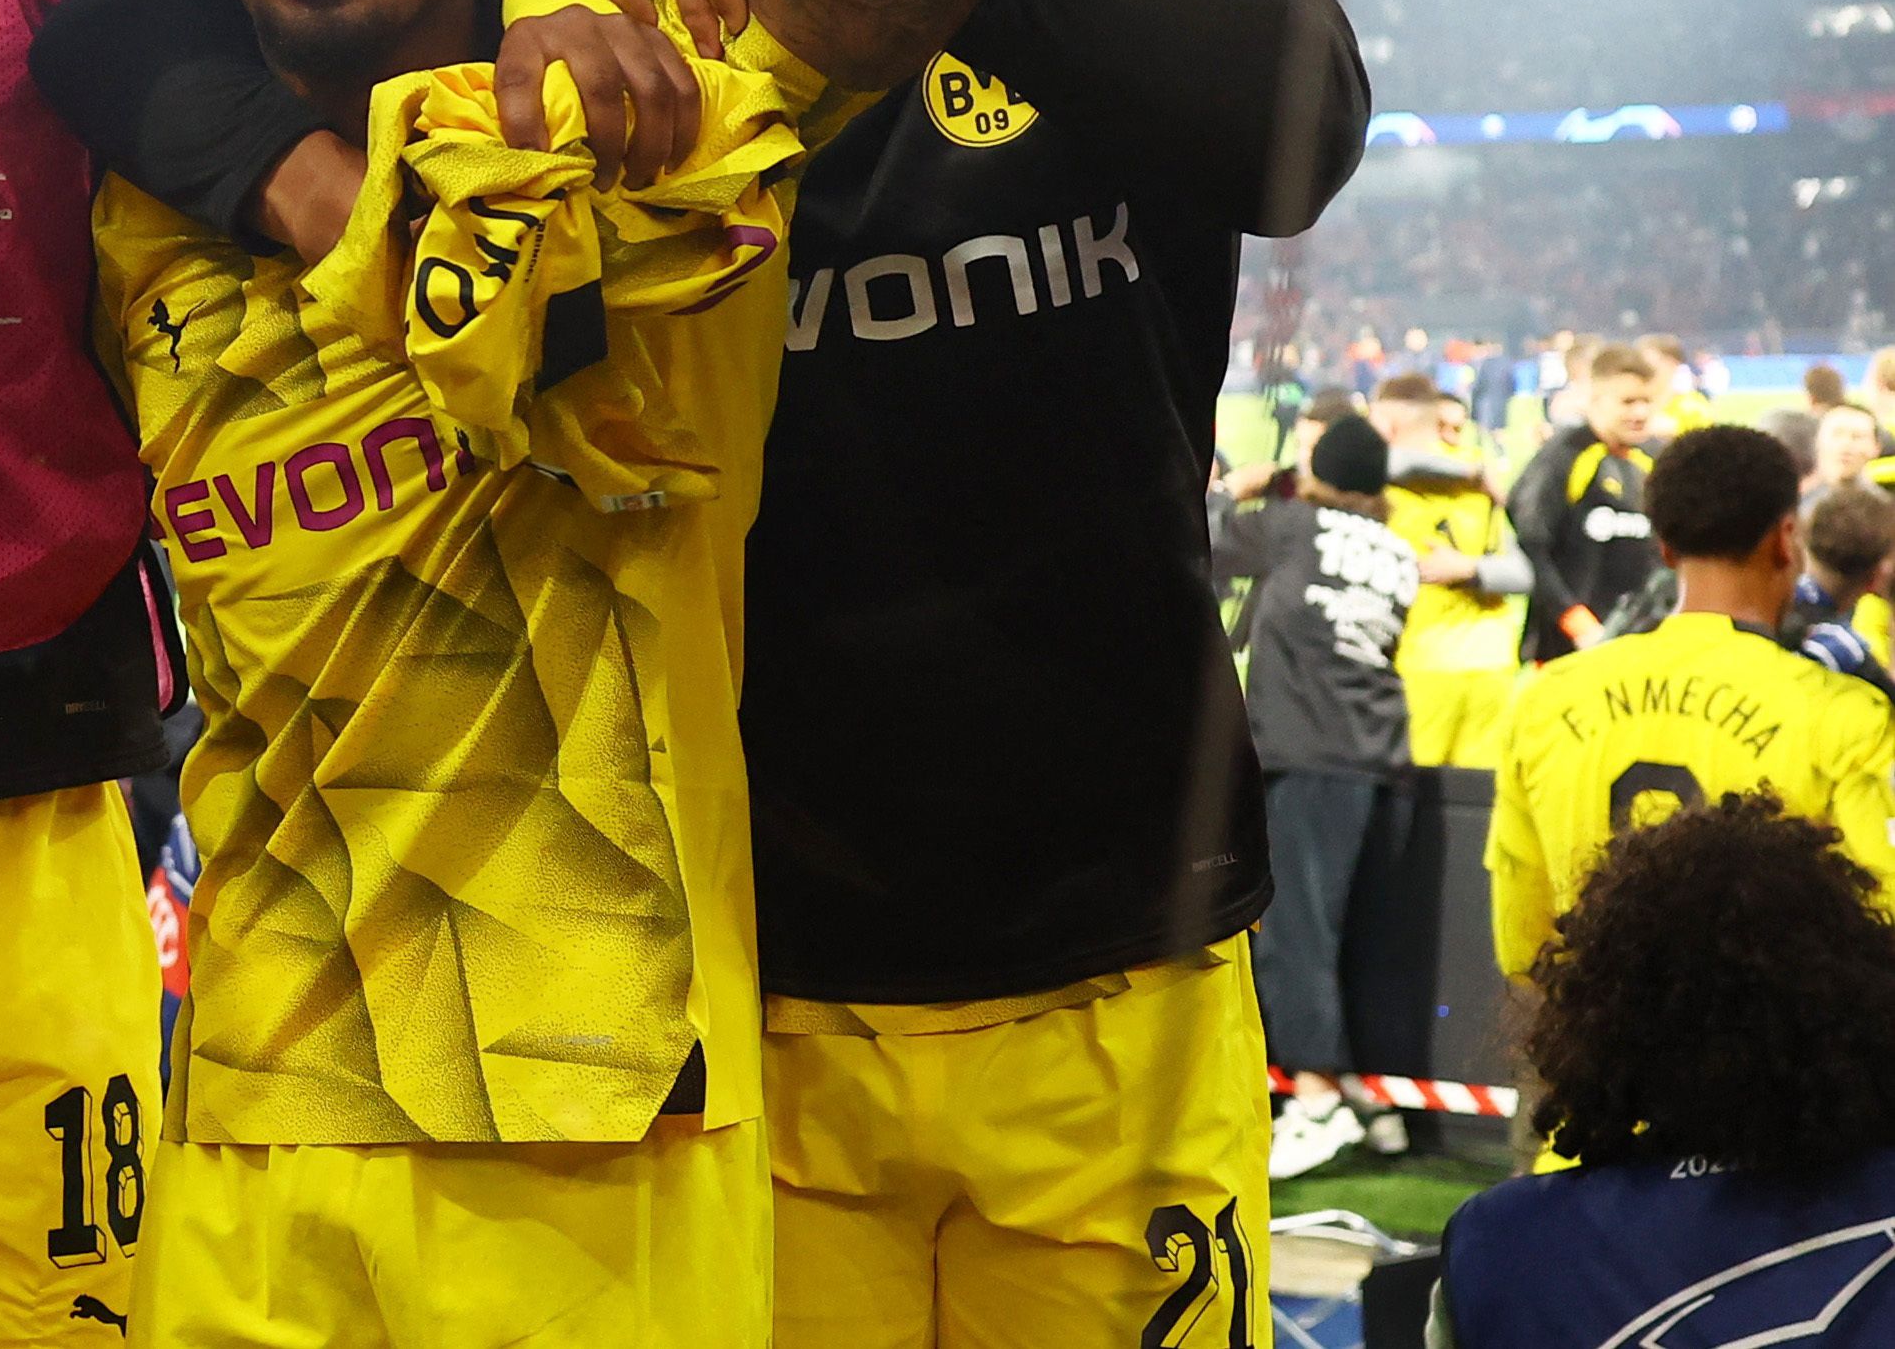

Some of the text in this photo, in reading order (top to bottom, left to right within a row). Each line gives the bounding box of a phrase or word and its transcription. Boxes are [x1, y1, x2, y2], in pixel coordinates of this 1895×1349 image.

[974, 108, 1010, 135] 09
[1561, 675, 1783, 759] F. NMECHA
[44, 1073, 147, 1270] 18
[1139, 1195, 1255, 1349] 21
